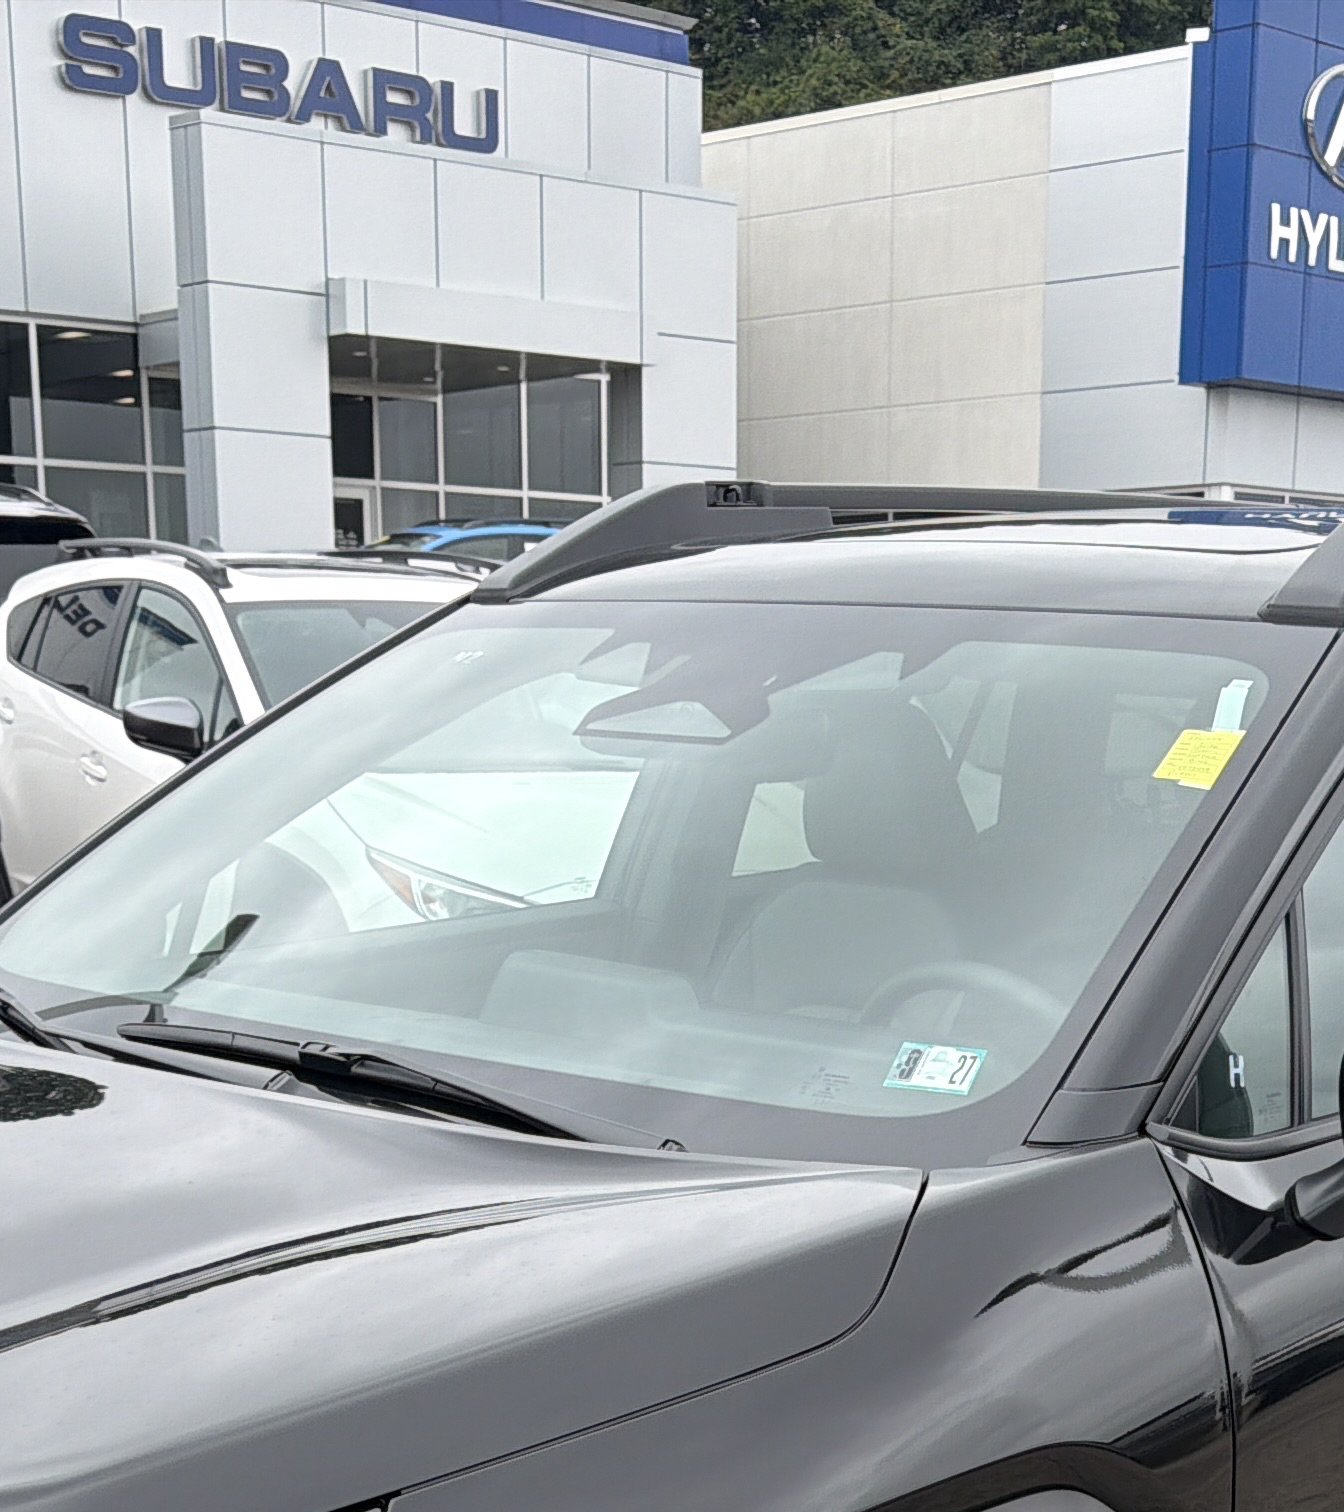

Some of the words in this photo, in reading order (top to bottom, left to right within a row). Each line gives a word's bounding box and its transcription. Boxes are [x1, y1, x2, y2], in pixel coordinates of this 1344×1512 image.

[60, 12, 500, 155] SUBARU
[948, 1055, 978, 1086] 27
[1229, 1054, 1245, 1088] H
